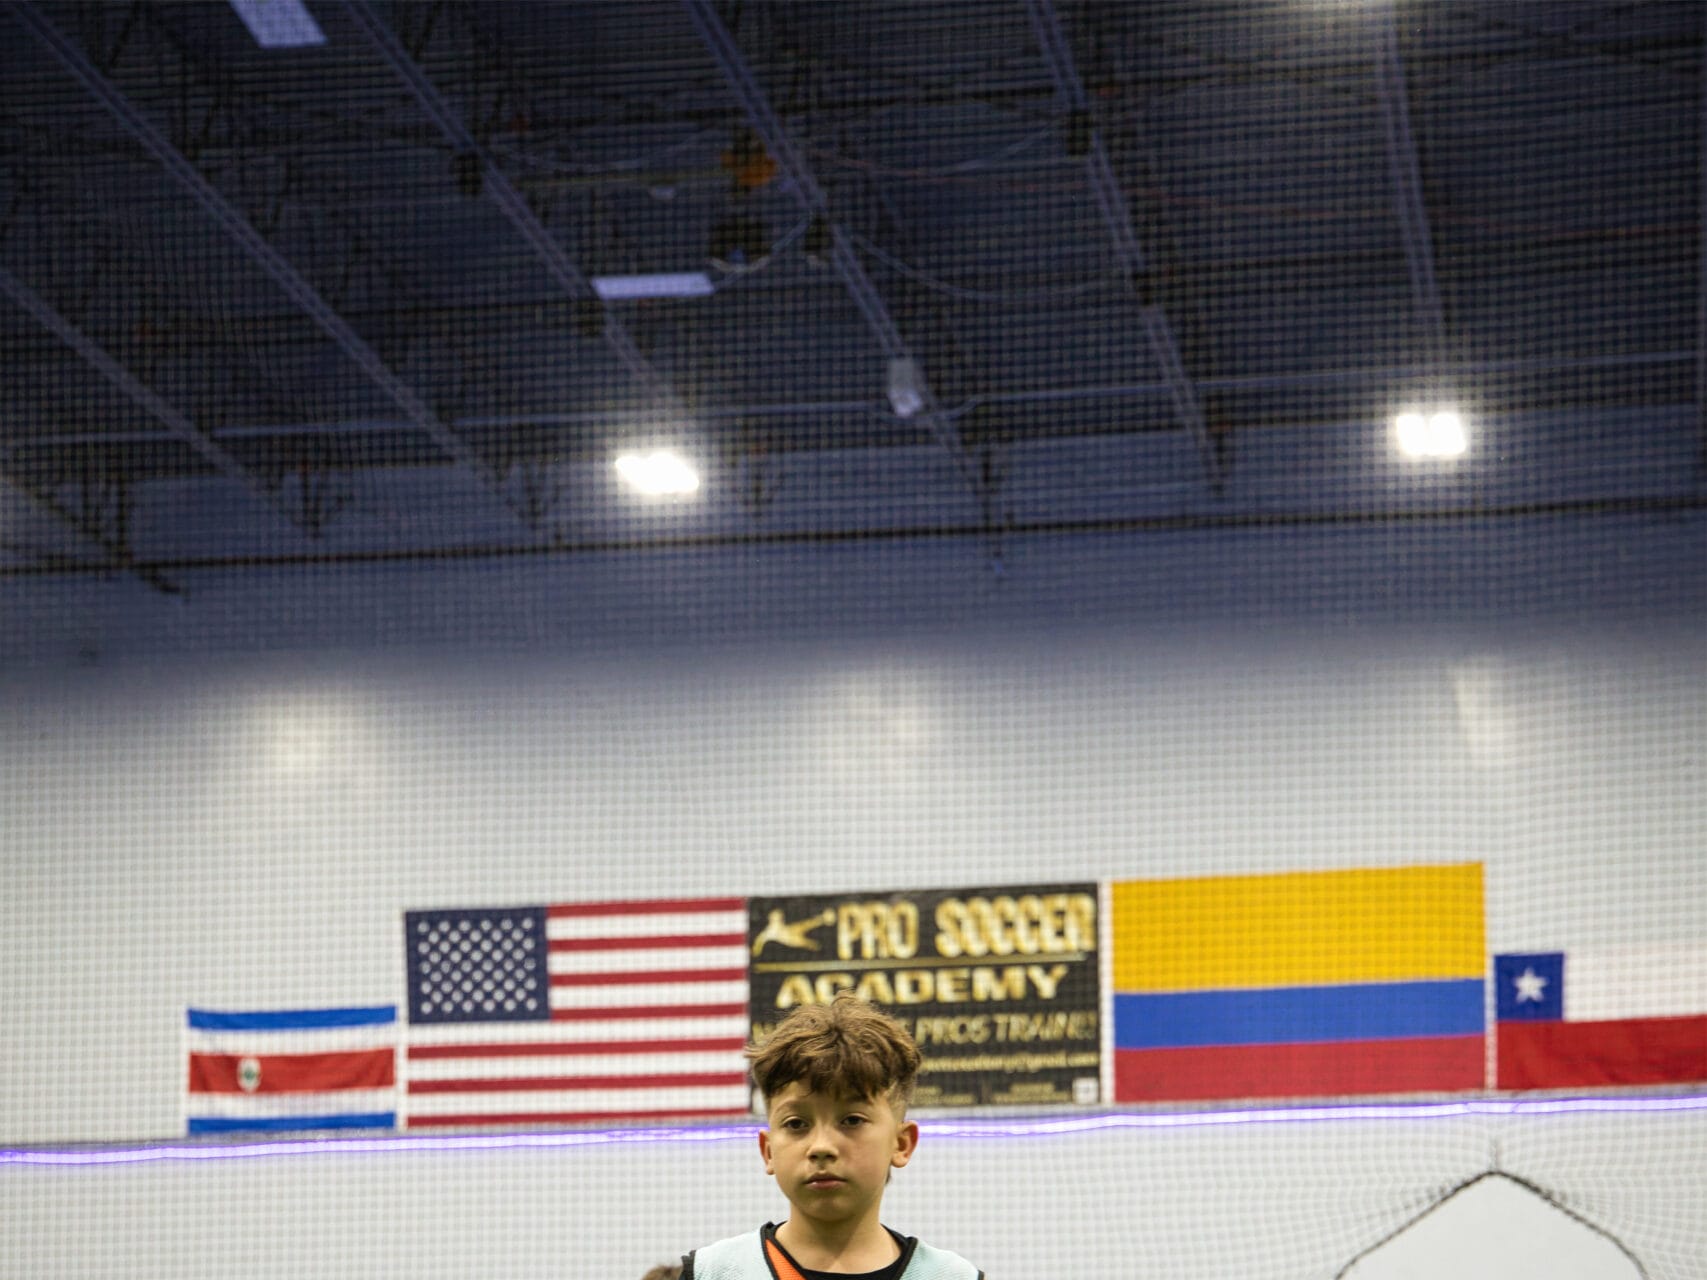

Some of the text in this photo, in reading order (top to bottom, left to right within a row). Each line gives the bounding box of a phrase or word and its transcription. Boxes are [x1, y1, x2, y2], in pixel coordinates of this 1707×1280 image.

[837, 893, 1096, 960] PRO SOCCER
[776, 964, 1069, 1009] ACADEMY
